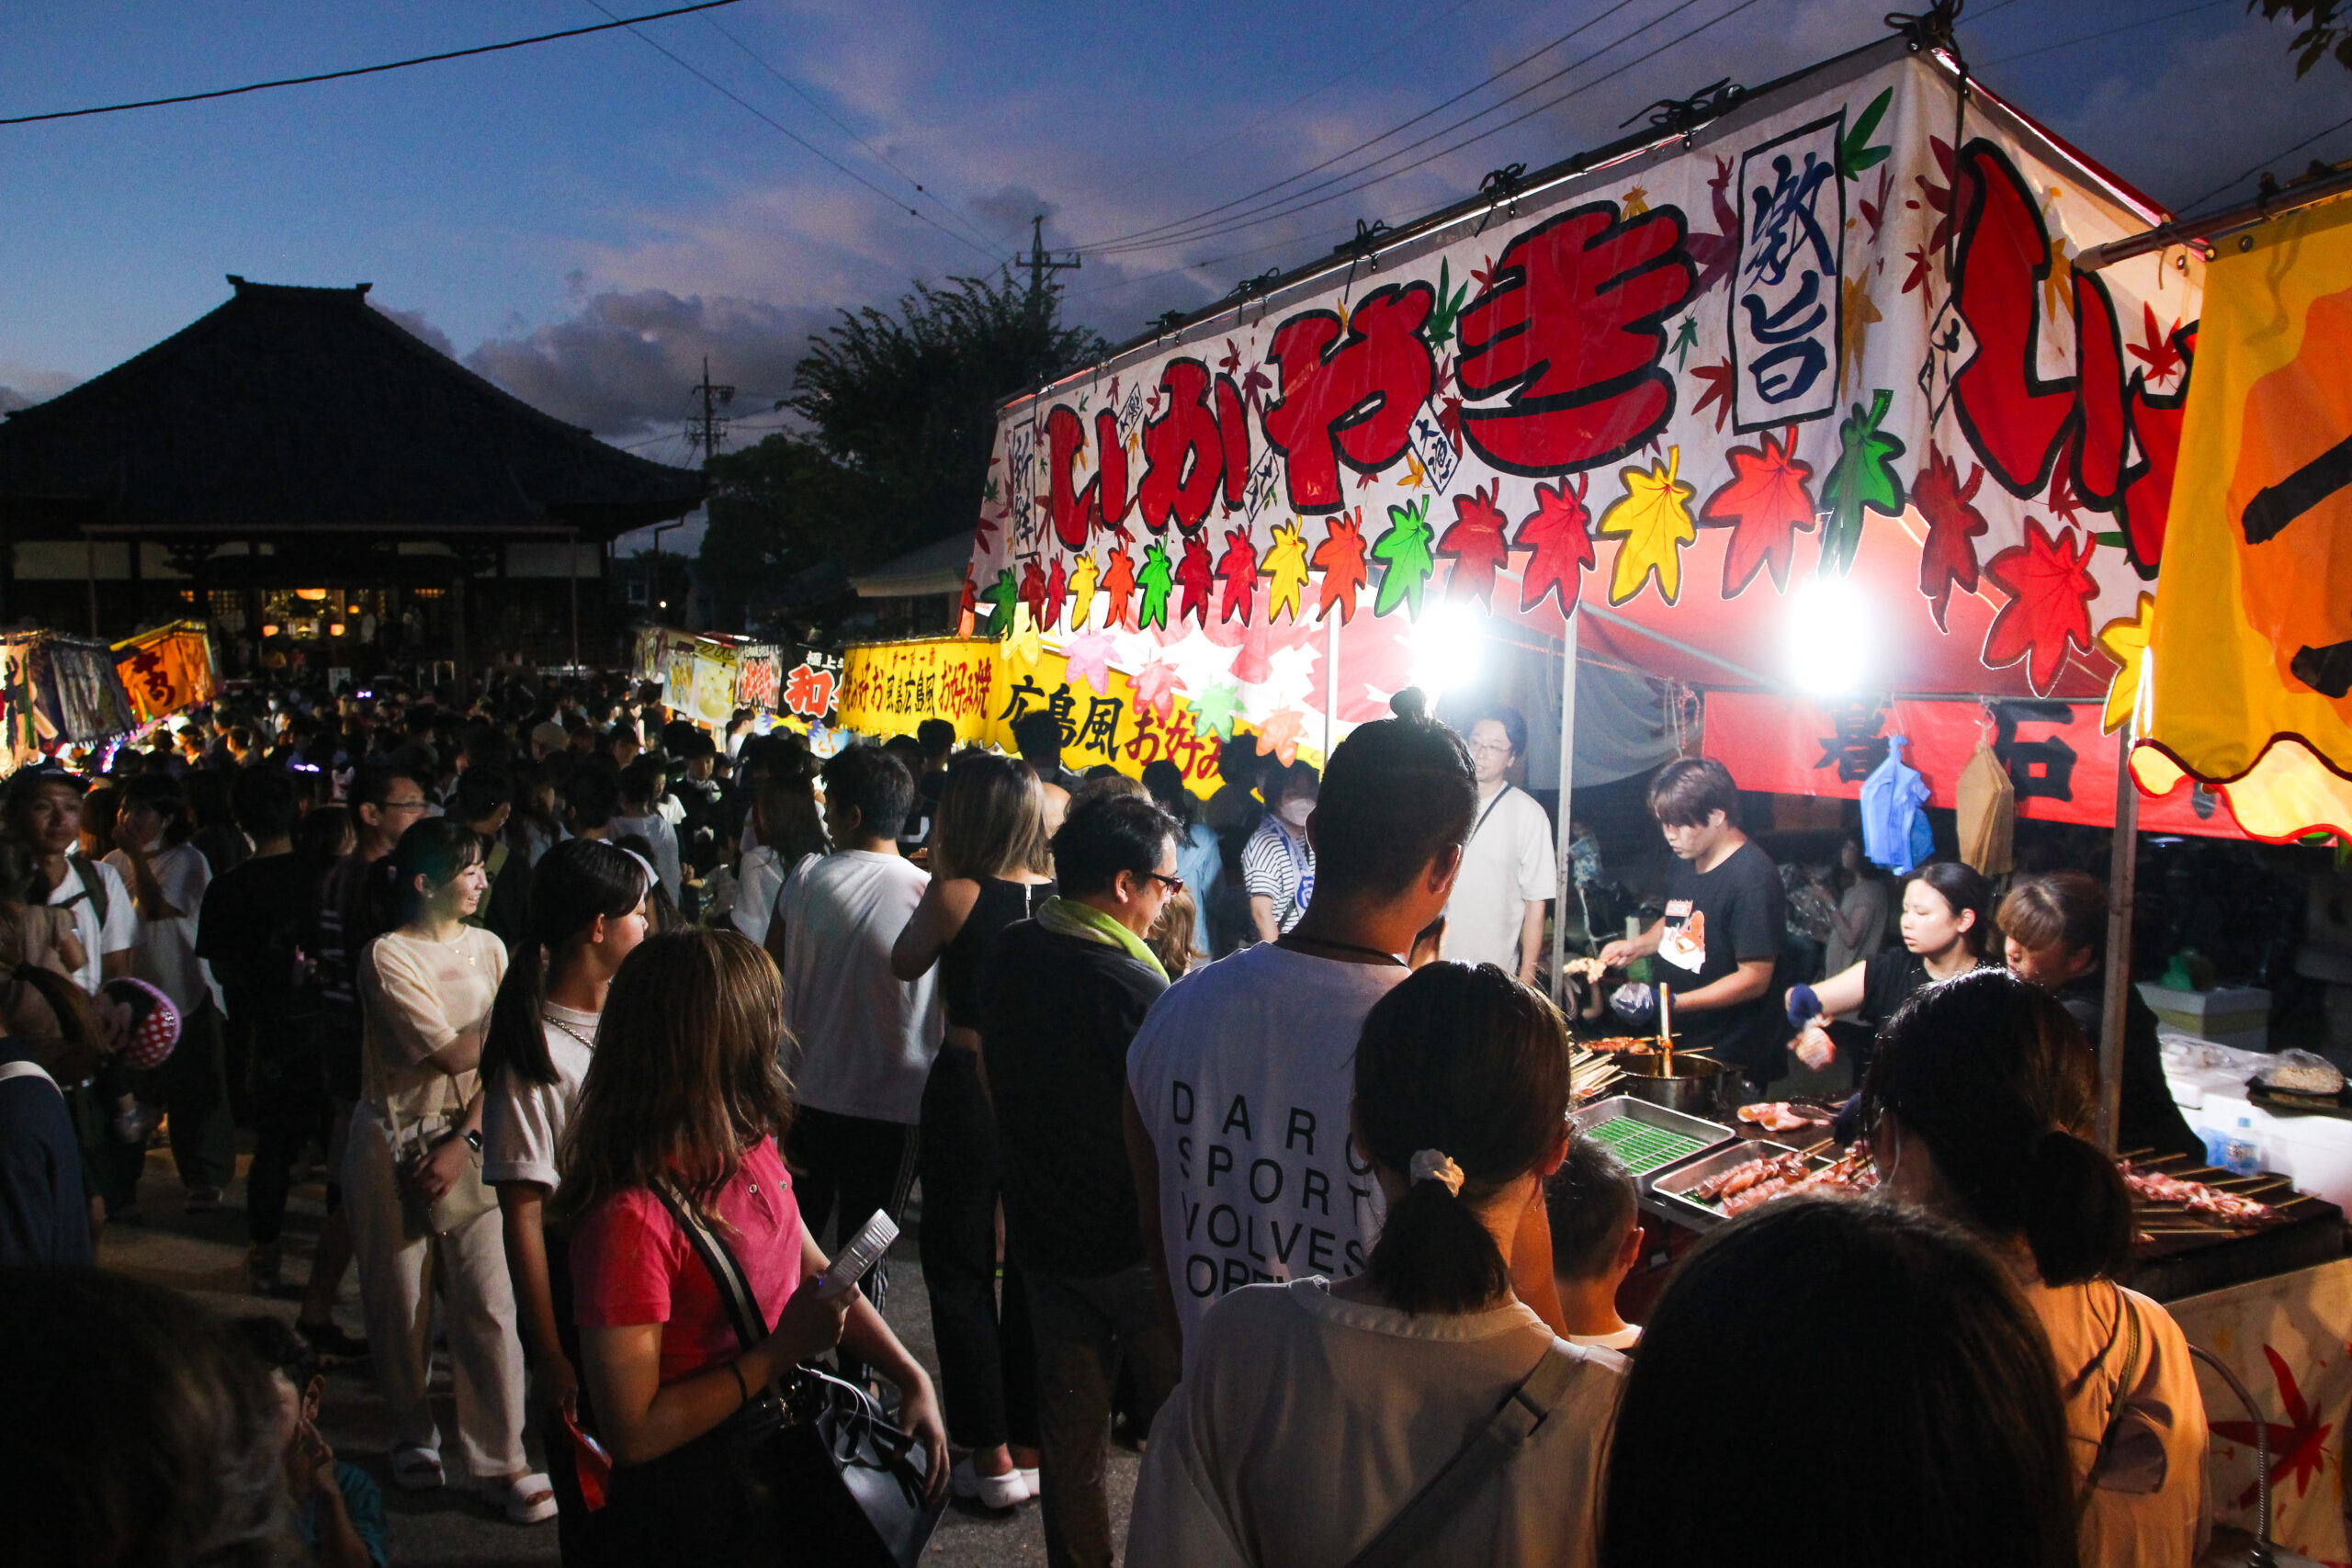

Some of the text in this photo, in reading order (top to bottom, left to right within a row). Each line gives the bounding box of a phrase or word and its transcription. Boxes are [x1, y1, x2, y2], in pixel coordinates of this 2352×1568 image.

[1044, 199, 1698, 552] いかやき
[1178, 1136, 1371, 1226] SPORT
